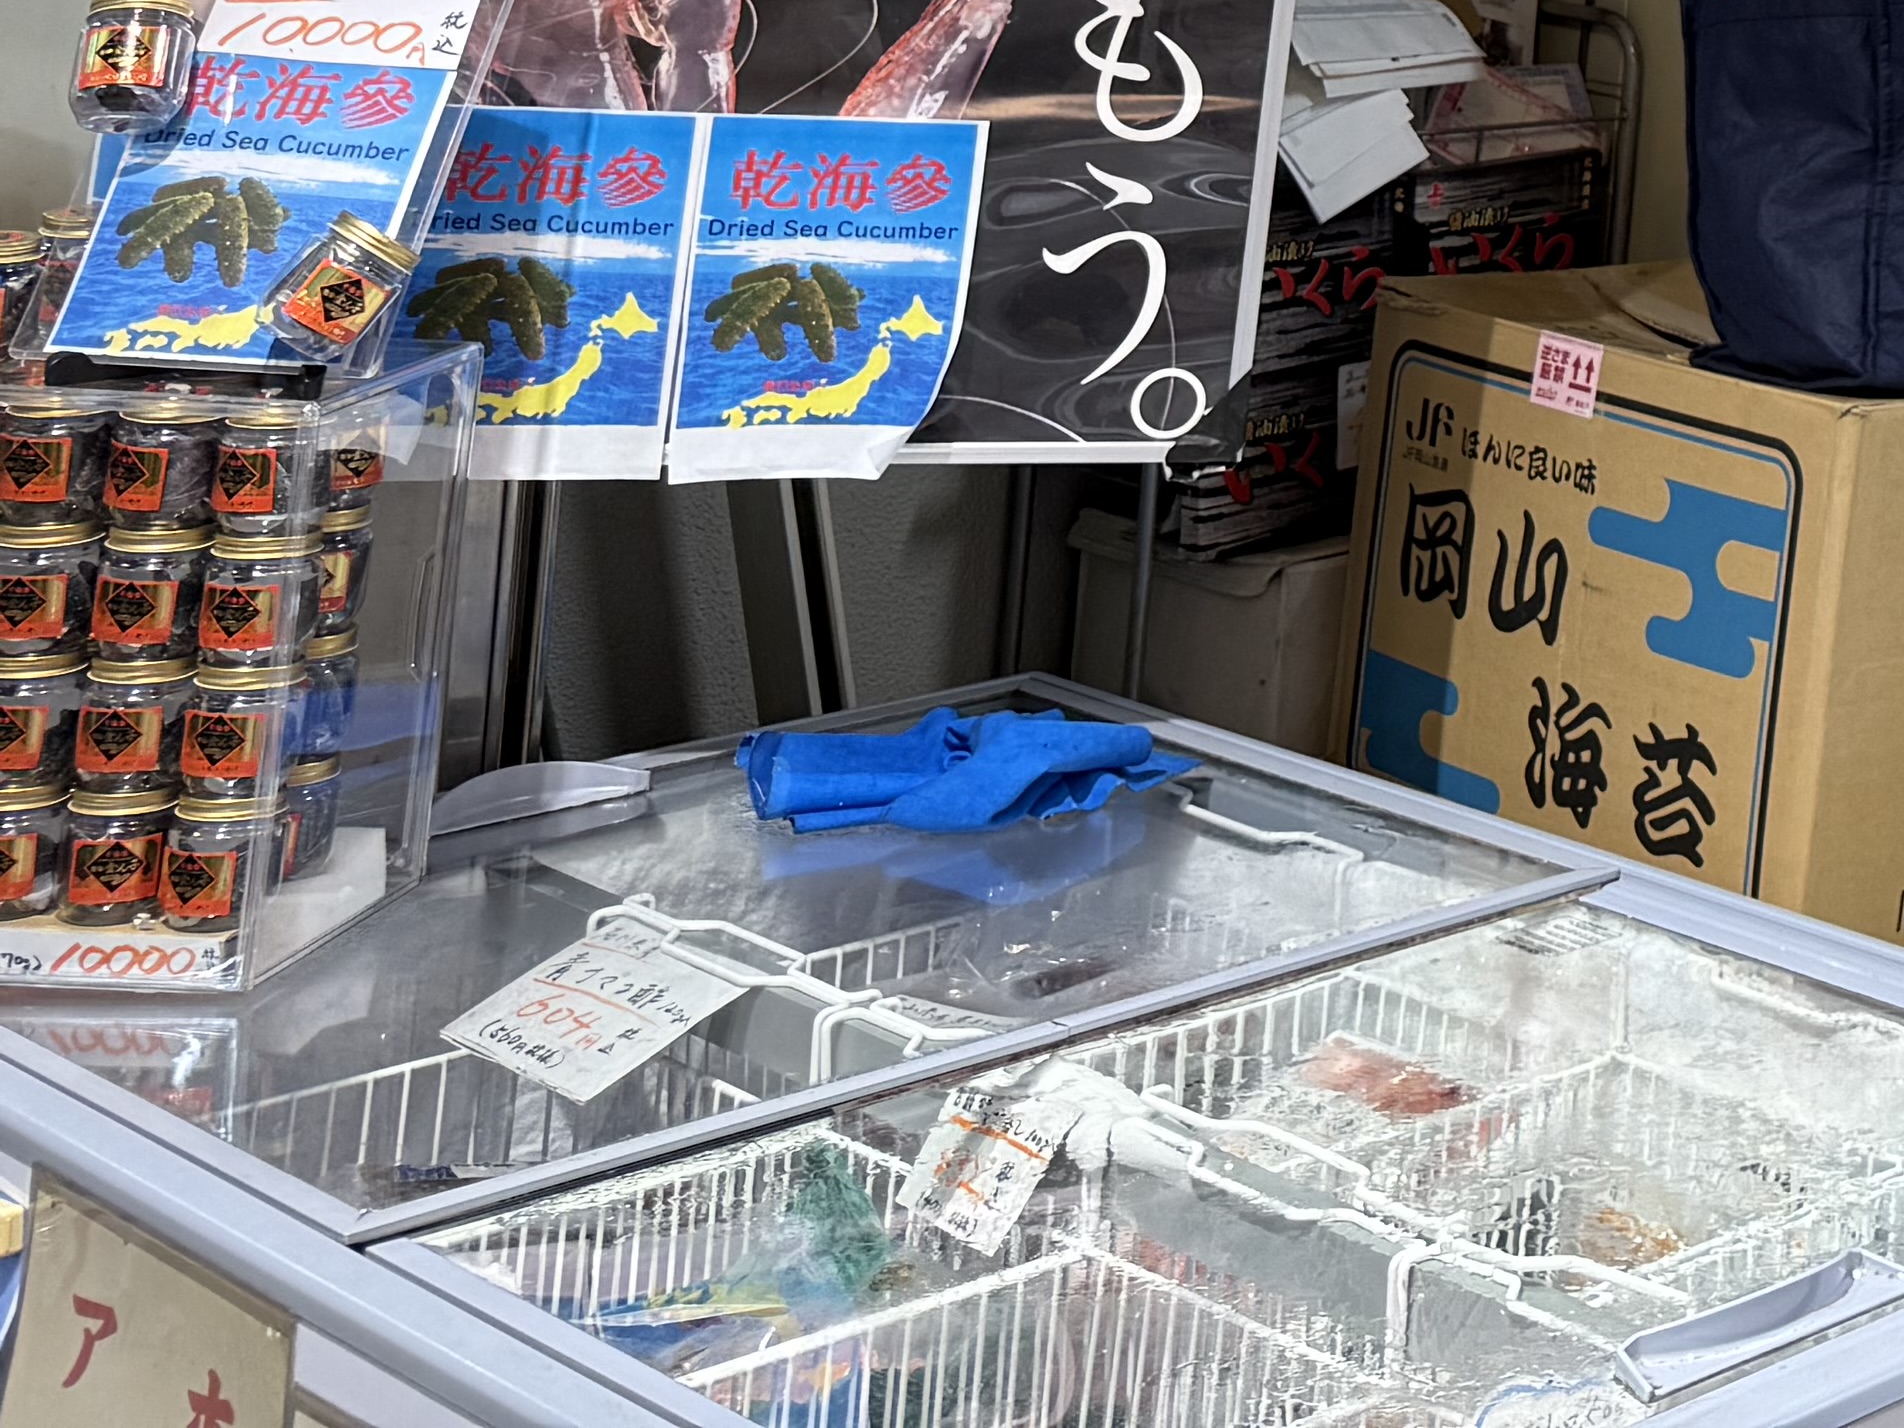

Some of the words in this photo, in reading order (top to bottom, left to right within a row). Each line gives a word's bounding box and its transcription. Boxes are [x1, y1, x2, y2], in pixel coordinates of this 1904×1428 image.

[431, 12, 469, 56] 税込
[221, 131, 269, 149] Sea
[277, 135, 410, 162] Cucumber
[430, 213, 483, 236] ried
[488, 213, 539, 236] Sea
[545, 215, 675, 241] Cucumber
[707, 218, 774, 241] Dried
[783, 219, 827, 240] Sea
[836, 221, 960, 244] Cucumber
[1431, 211, 1575, 275] いくら
[1265, 240, 1314, 262] 油漬け
[1461, 427, 1597, 495] ほんに良い味
[1402, 480, 1570, 647] 岡山
[1525, 675, 1719, 868] 海苔
[51, 942, 196, 978] 10000
